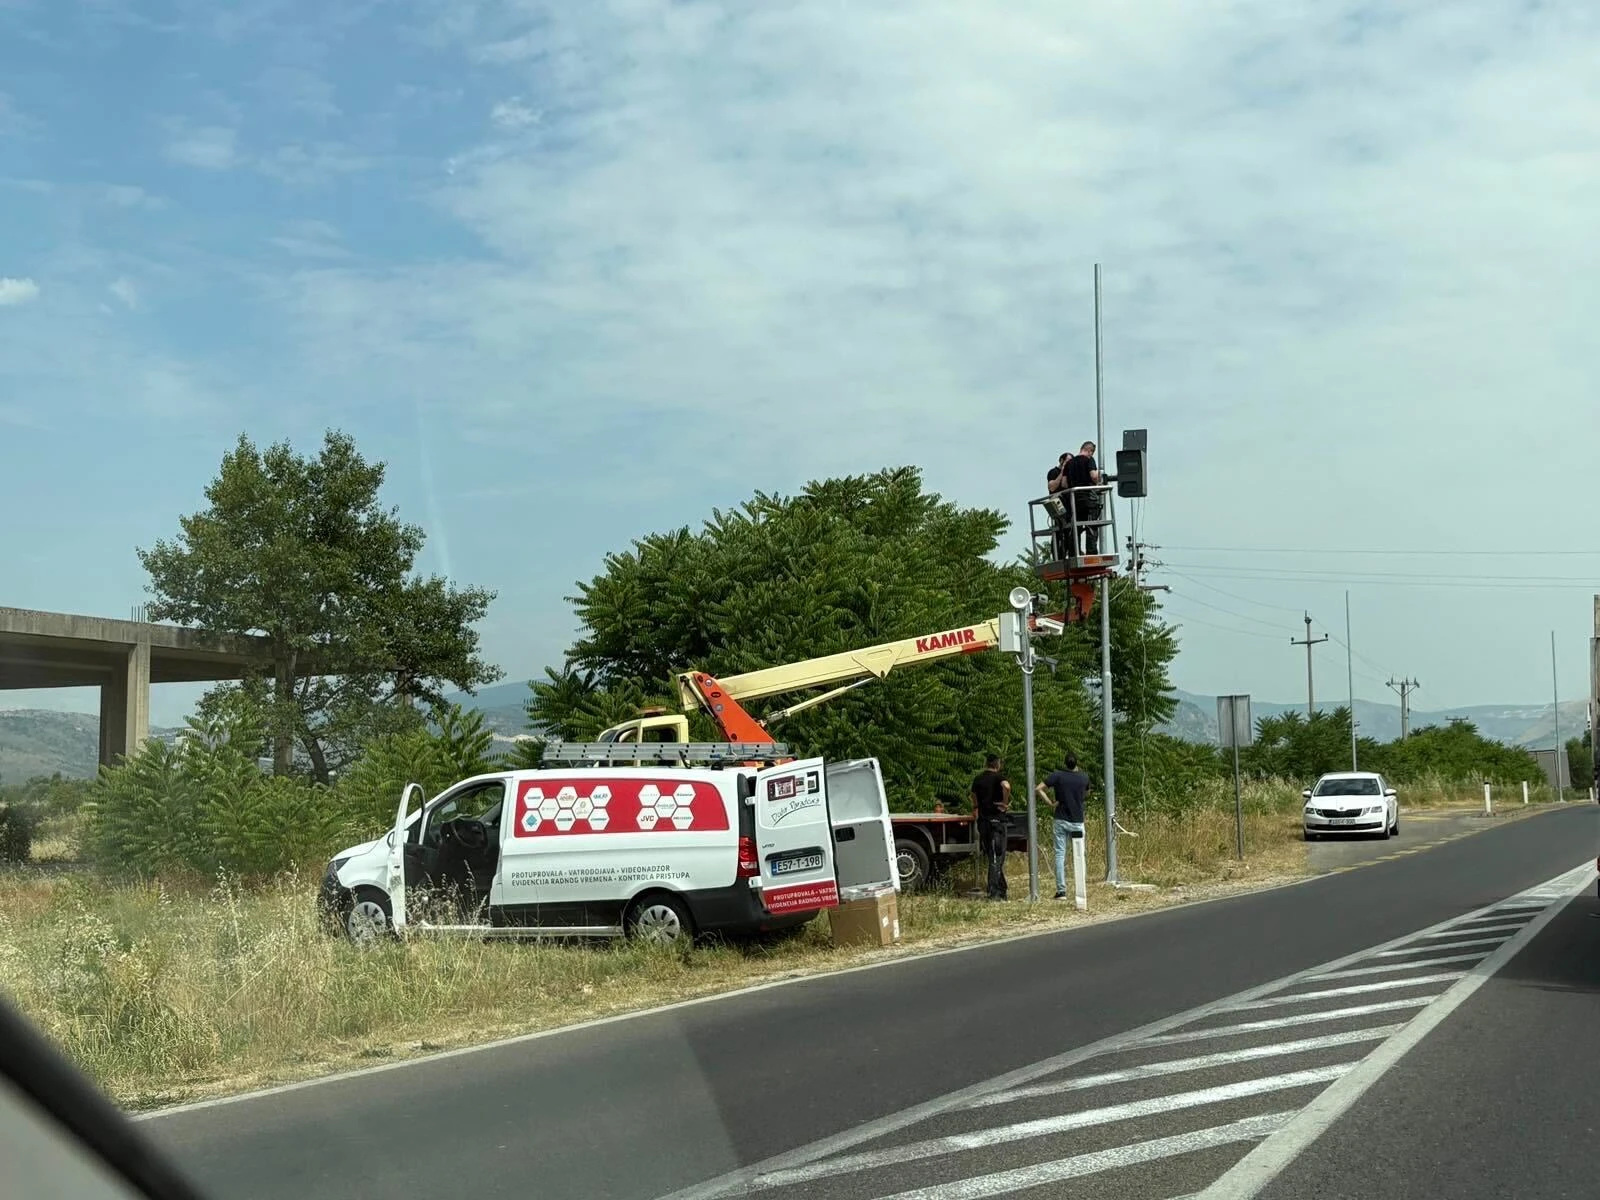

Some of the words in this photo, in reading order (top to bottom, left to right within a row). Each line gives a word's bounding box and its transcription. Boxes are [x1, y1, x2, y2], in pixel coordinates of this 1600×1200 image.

[915, 628, 976, 653] KAMIR
[511, 870, 563, 879] PROTUPROVALA
[568, 867, 616, 876] VATRODOJAVA
[620, 864, 670, 874] VIDEONADZOR
[777, 855, 821, 872] E57-T-198
[511, 878, 550, 887] EVIDENCIJA
[550, 876, 579, 885] RADNOG
[579, 875, 613, 884] VREMENA
[618, 873, 655, 882] KONTROLA
[655, 871, 691, 880] PRISTUPA
[773, 889, 815, 901] PROTUPROVALA
